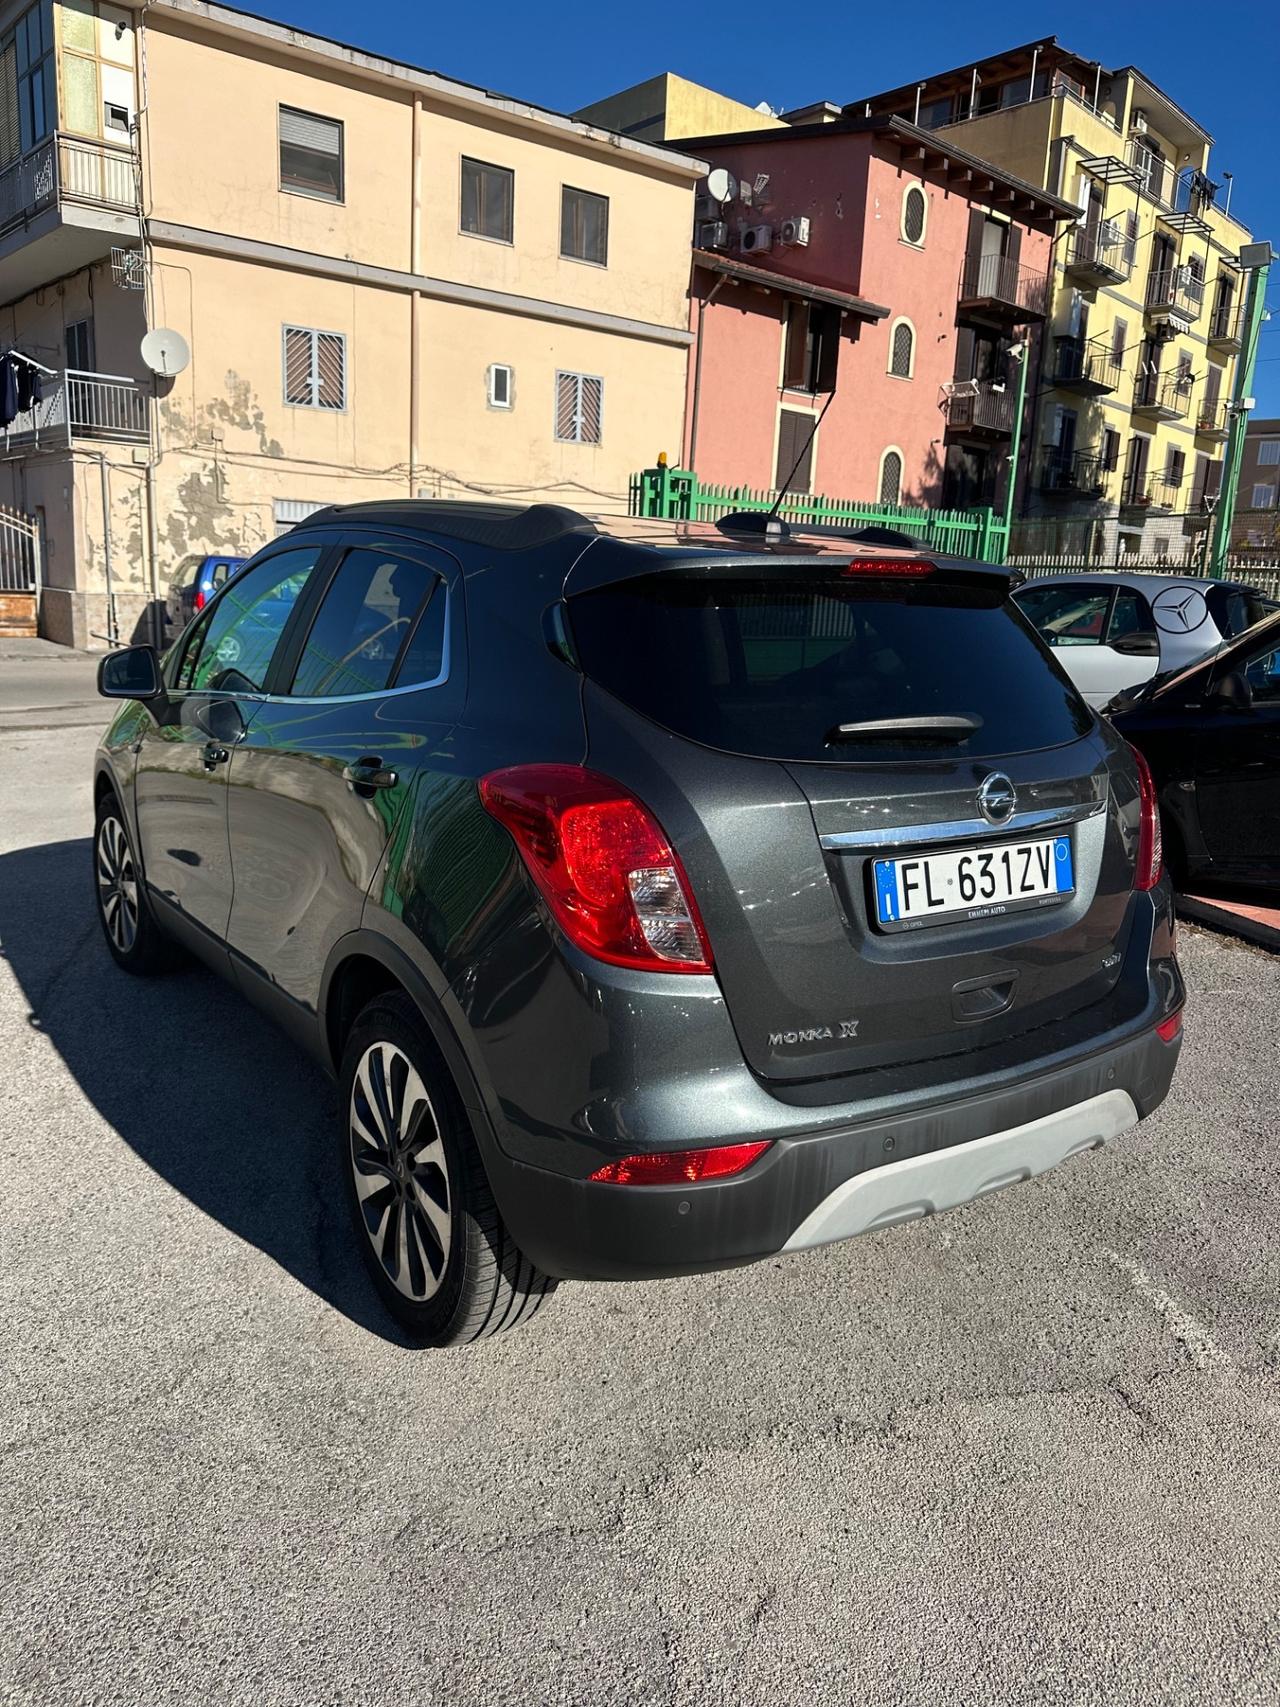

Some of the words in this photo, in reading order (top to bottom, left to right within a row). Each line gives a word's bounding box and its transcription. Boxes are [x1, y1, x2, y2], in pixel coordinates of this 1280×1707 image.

[901, 861, 944, 911] FL
[958, 845, 1050, 901] 631ZV
[990, 906, 1006, 915] AUTO
[768, 1027, 833, 1046] MOKKA
[840, 1020, 859, 1039] X
